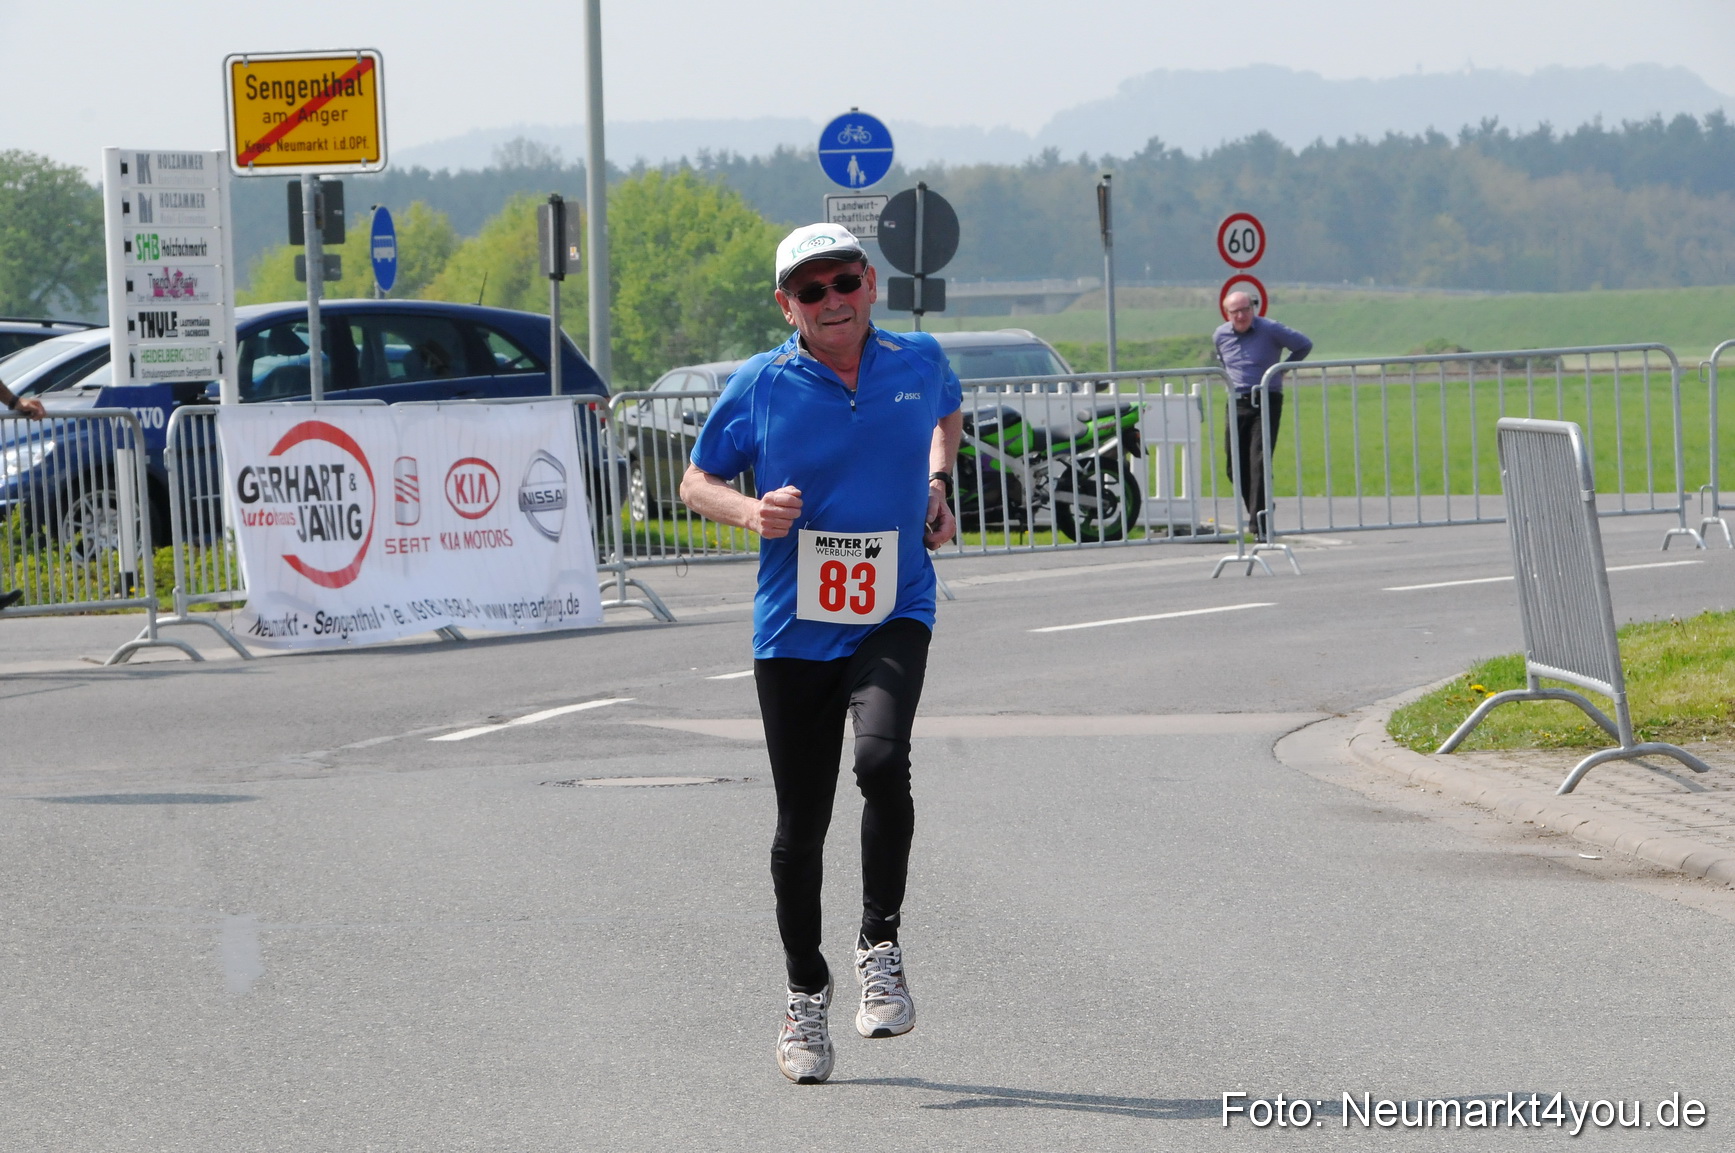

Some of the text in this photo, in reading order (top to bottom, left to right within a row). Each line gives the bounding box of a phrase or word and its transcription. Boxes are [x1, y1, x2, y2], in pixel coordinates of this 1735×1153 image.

[245, 70, 363, 106] Sengenthal
[262, 107, 348, 126] am Anger
[244, 140, 272, 153] Kreis
[276, 139, 328, 152] Neumarkt
[157, 153, 204, 170] HOLZAMMER
[159, 192, 205, 208] HOLZAMMER
[836, 201, 879, 211] Landwirt-
[833, 212, 880, 223] schaftliche
[135, 233, 207, 263] SHB Holzfachmarkt
[1228, 228, 1255, 253] 60
[138, 310, 178, 338] THULE
[237, 464, 357, 504] GERHART &
[453, 473, 490, 504] KIA
[297, 503, 362, 543] JÄNIG
[384, 537, 431, 554] SEAT
[440, 528, 513, 550] KIA MOTORS
[815, 536, 862, 549] MEYER
[815, 548, 862, 558] WERBUNG
[819, 560, 876, 615] 83
[313, 606, 382, 639] Sengenthal
